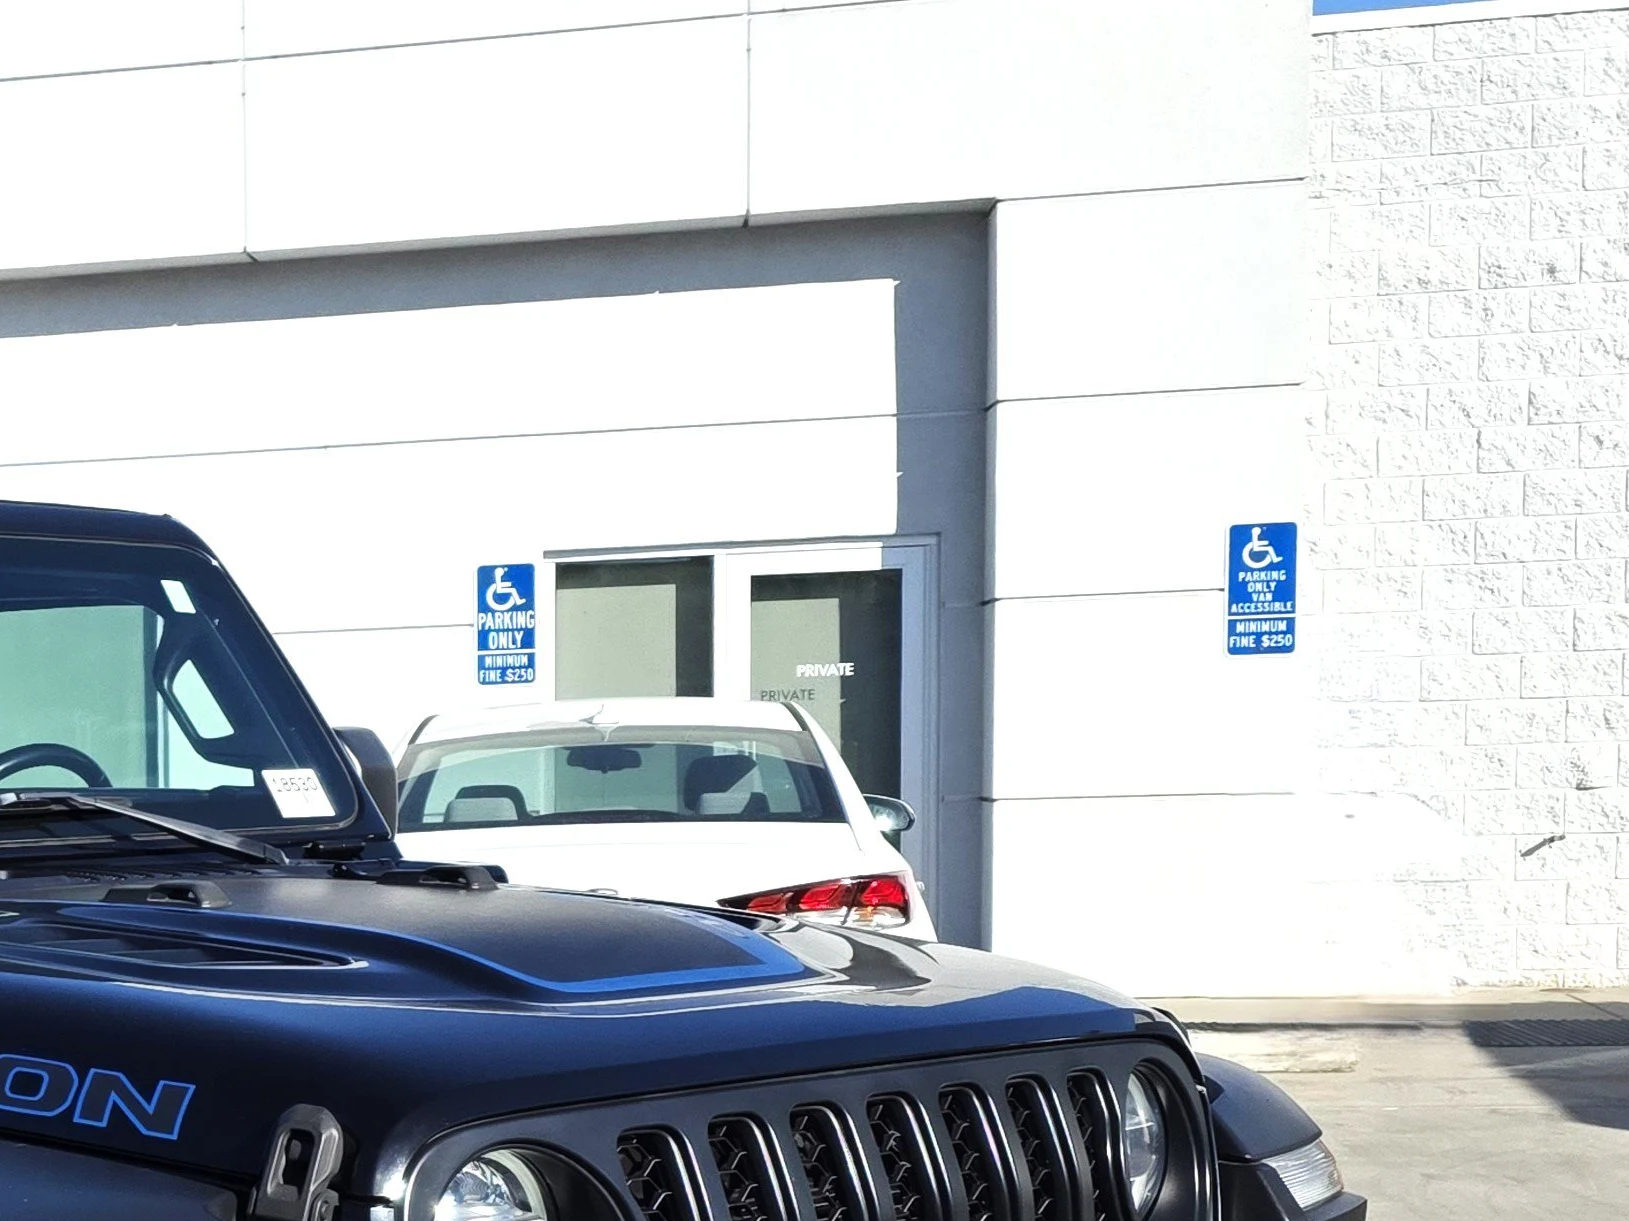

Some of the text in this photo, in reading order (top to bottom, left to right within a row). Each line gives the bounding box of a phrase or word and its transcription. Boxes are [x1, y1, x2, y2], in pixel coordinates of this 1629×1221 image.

[1238, 570, 1287, 582] PARKING
[1247, 581, 1277, 592] ONLY
[1252, 592, 1273, 602] VAN
[1230, 601, 1294, 613] ACCESSIBLE
[478, 610, 535, 631] PARKING
[1236, 620, 1287, 634] MINIMUM
[488, 631, 524, 650] ONLY
[1229, 634, 1294, 648] FINE $250
[485, 654, 529, 669] MINIMUM
[479, 667, 534, 683] FINE $250
[796, 662, 855, 677] PRIVATE
[760, 688, 815, 702] PRIVATE
